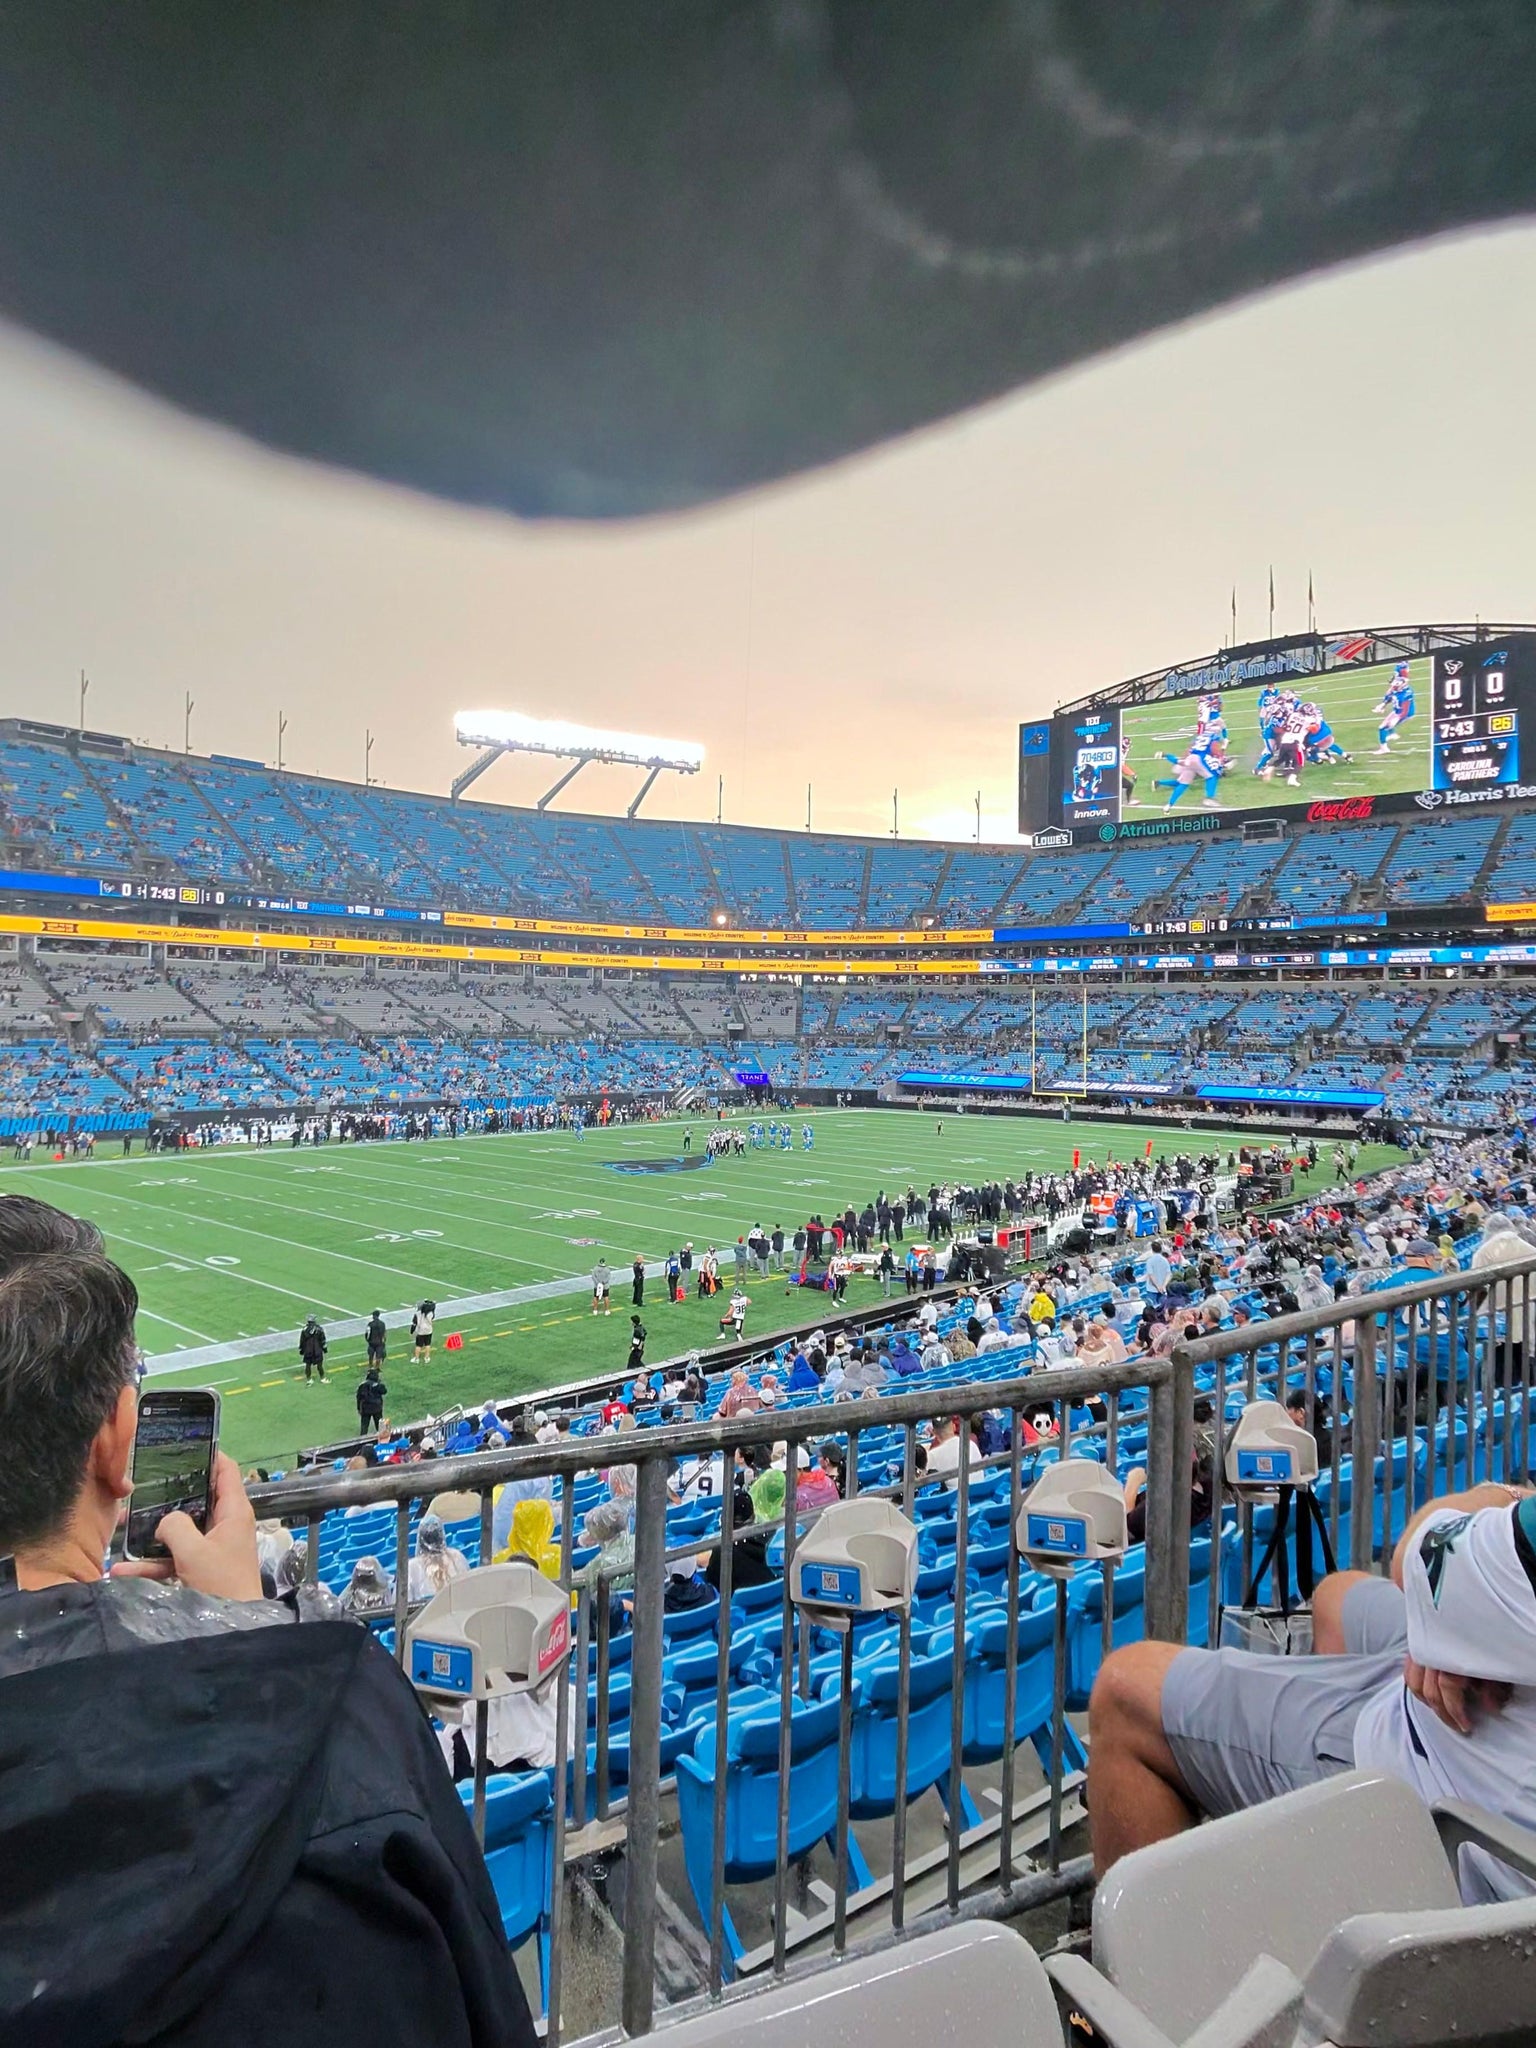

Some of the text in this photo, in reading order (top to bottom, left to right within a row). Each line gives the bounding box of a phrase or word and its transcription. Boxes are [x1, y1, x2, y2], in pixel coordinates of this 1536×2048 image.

[1166, 654, 1316, 692] Bank of America
[1445, 672, 1503, 700] 0 0
[1085, 716, 1100, 726] TEXT
[1440, 717, 1511, 738] 7:43 26
[1447, 759, 1493, 773] CAROLINA
[1452, 767, 1500, 782] PANTHERS
[1445, 787, 1504, 804] Harris
[1119, 816, 1220, 838] Atrium Health
[122, 883, 131, 896] 0
[150, 887, 176, 900] 7:43
[216, 892, 224, 904] 0
[1145, 923, 1152, 934] 0
[1166, 920, 1187, 933] 7:43
[1191, 921, 1203, 931] 26
[1219, 920, 1227, 931] 0
[1053, 1080, 1173, 1094] CAROLINA PANTHERS
[0, 1111, 155, 1137] AROLINA PANTHERS
